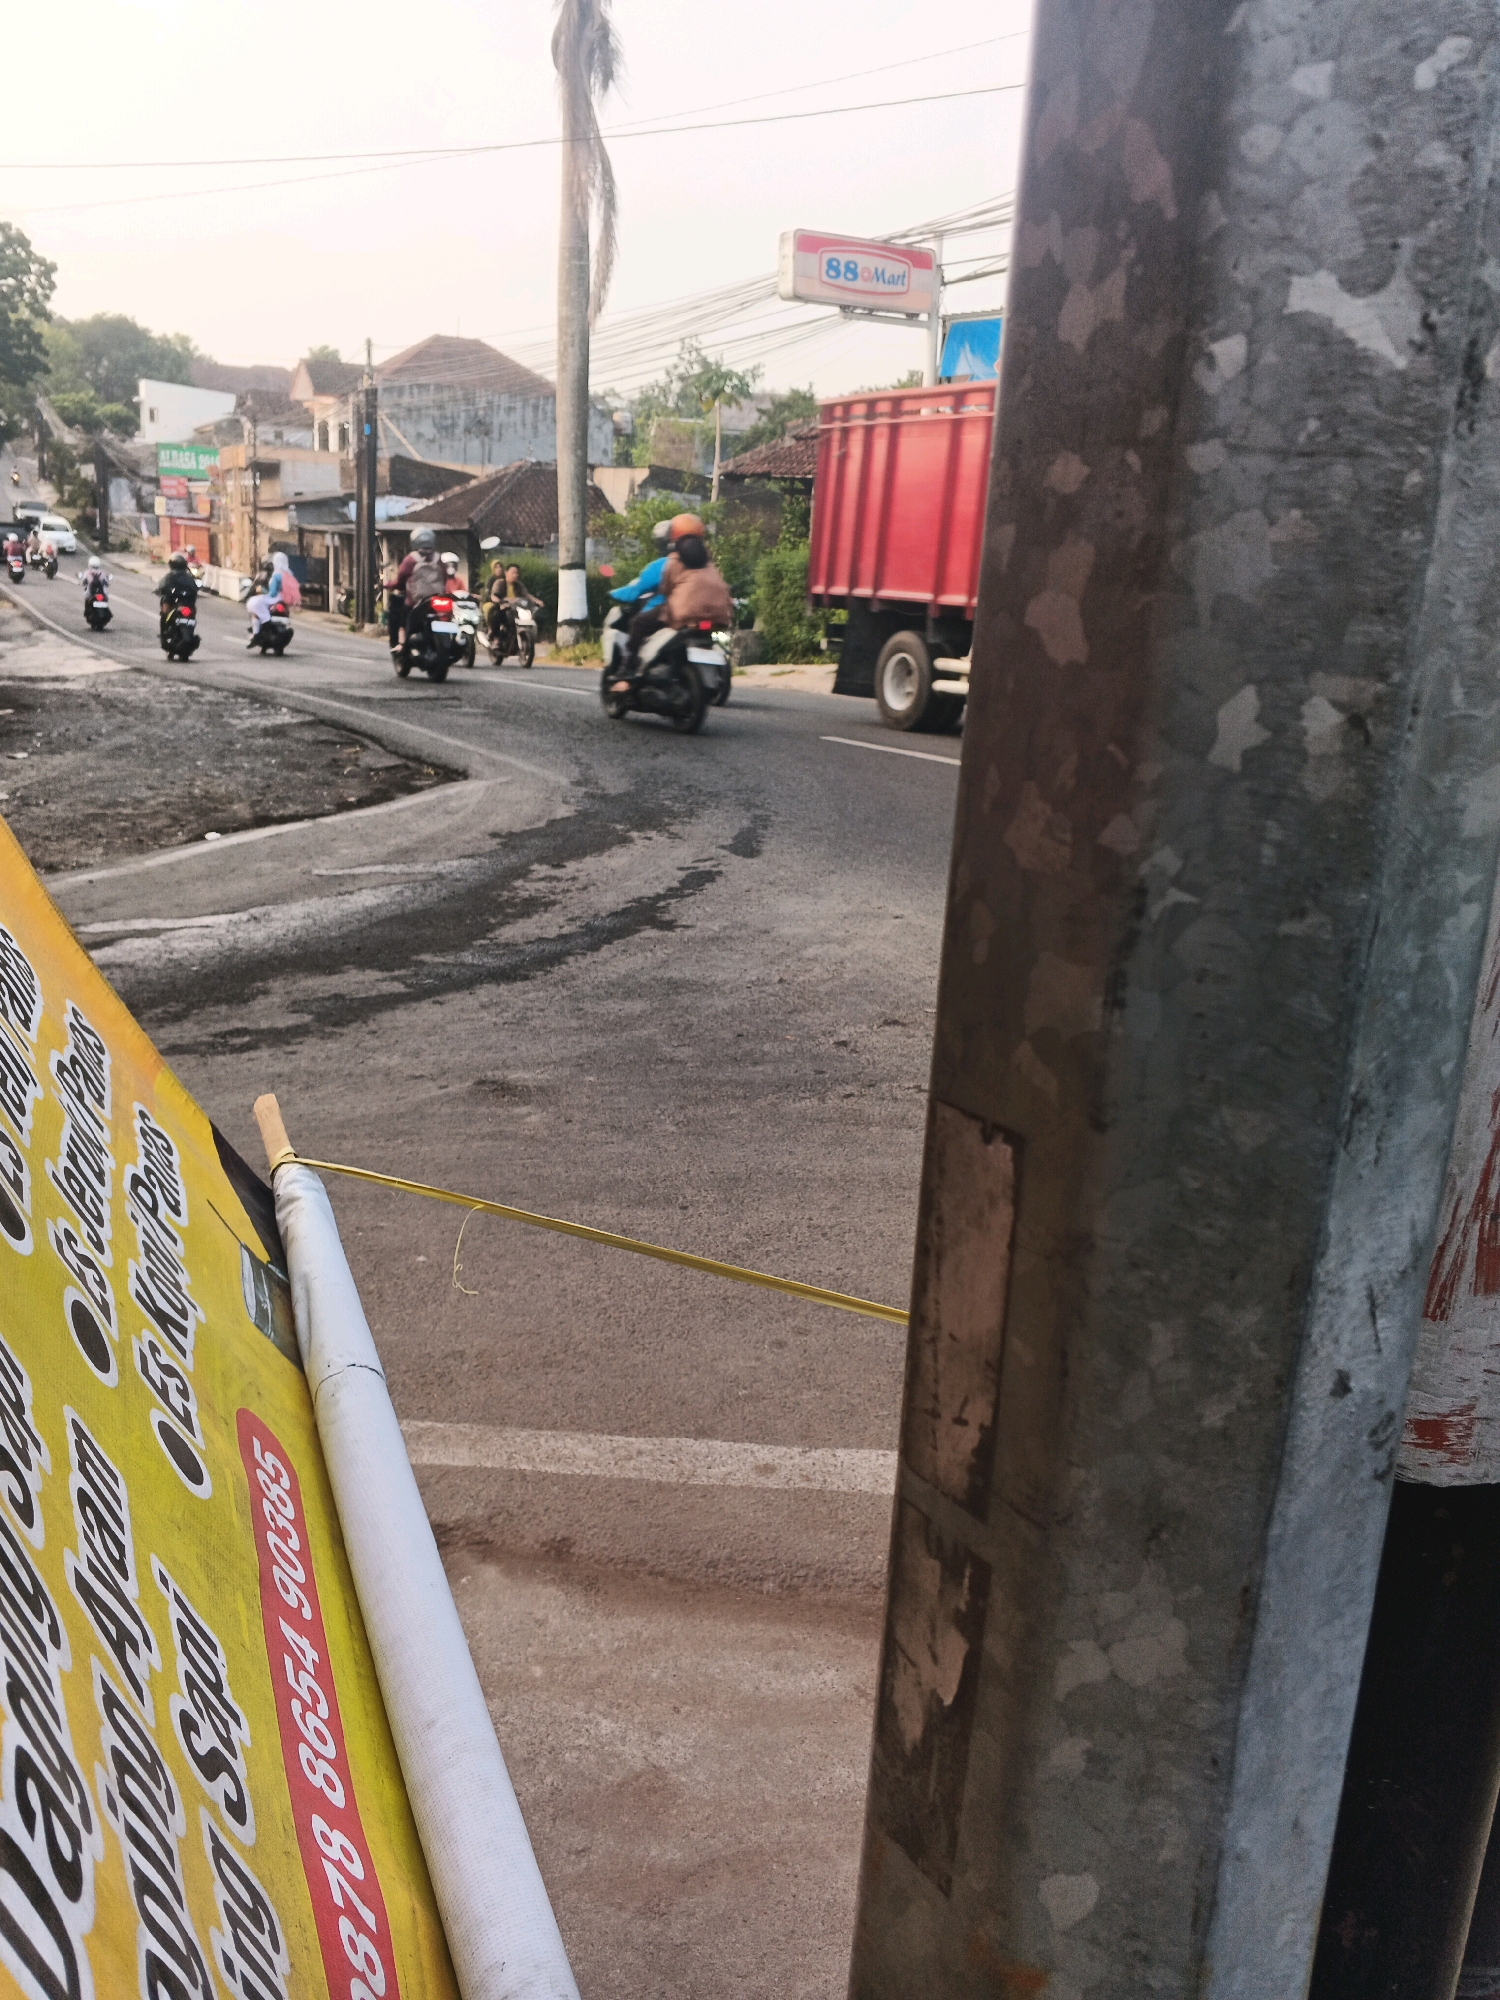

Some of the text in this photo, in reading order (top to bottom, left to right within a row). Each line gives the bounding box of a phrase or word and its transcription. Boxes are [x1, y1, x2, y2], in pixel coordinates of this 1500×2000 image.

[826, 257, 907, 286] 88 Mart
[51, 1005, 113, 1329] Es Jeruk/Panas
[129, 1109, 198, 1440] Es Kopi/Panas
[70, 1416, 153, 1707] Ayam
[252, 1435, 312, 1620] 90385
[158, 1567, 249, 1827] Sapi
[278, 1615, 346, 1809] 8654
